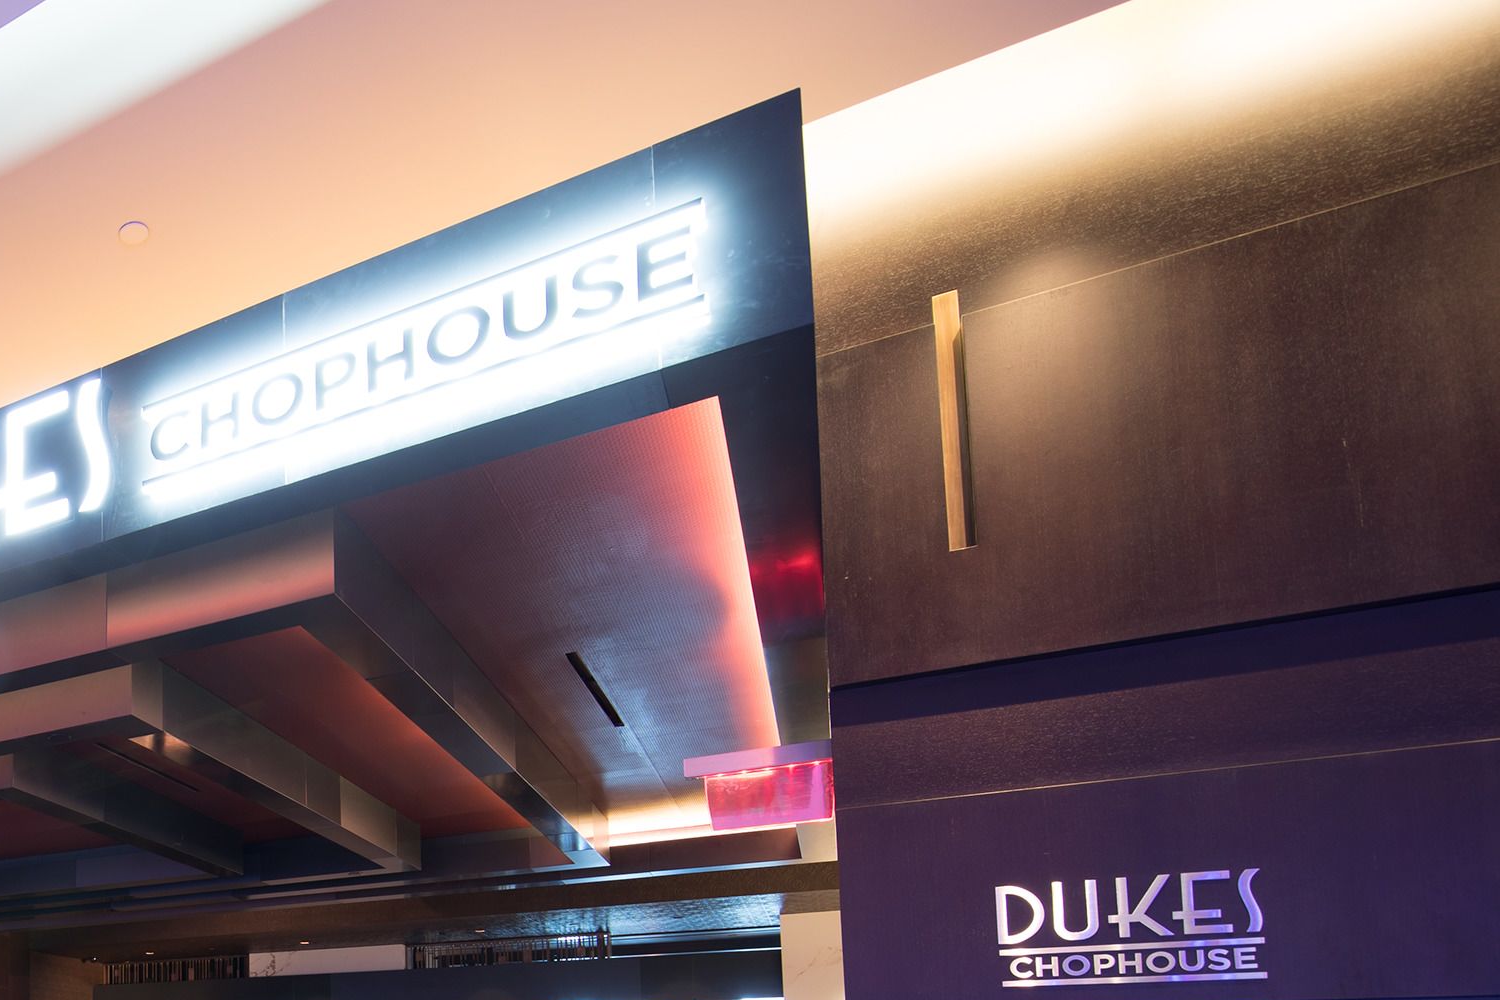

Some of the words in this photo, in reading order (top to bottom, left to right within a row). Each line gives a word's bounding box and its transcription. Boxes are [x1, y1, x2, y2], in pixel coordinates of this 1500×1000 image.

[150, 224, 695, 461] CHOPHOUSE
[995, 868, 1264, 945] DUKES
[1009, 946, 1259, 979] CHOPHOUSE
